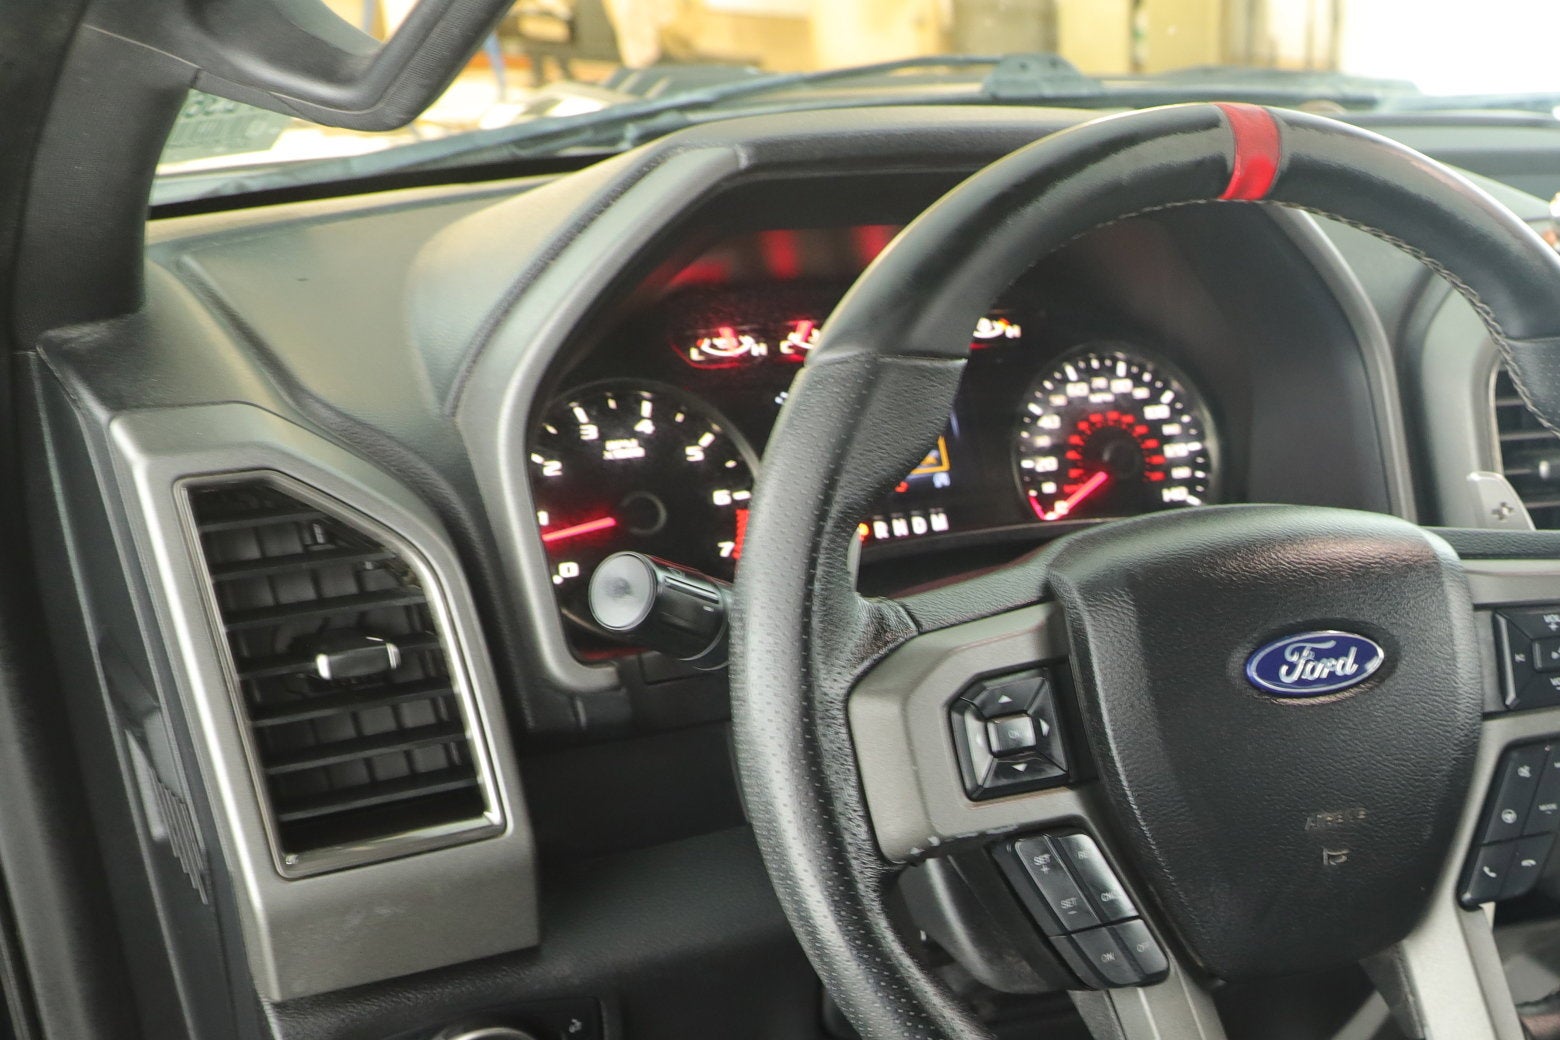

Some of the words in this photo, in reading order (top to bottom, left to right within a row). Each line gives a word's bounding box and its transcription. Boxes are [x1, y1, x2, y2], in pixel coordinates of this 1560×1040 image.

[580, 424, 598, 440] 3
[634, 419, 655, 434] 4
[685, 445, 704, 461] 5
[543, 461, 562, 477] 2
[713, 490, 731, 505] 6
[873, 521, 889, 539] R
[911, 516, 928, 535] D
[930, 513, 949, 532] M
[718, 541, 734, 557] 7
[559, 562, 579, 578] 0
[1279, 640, 1358, 684] Ford
